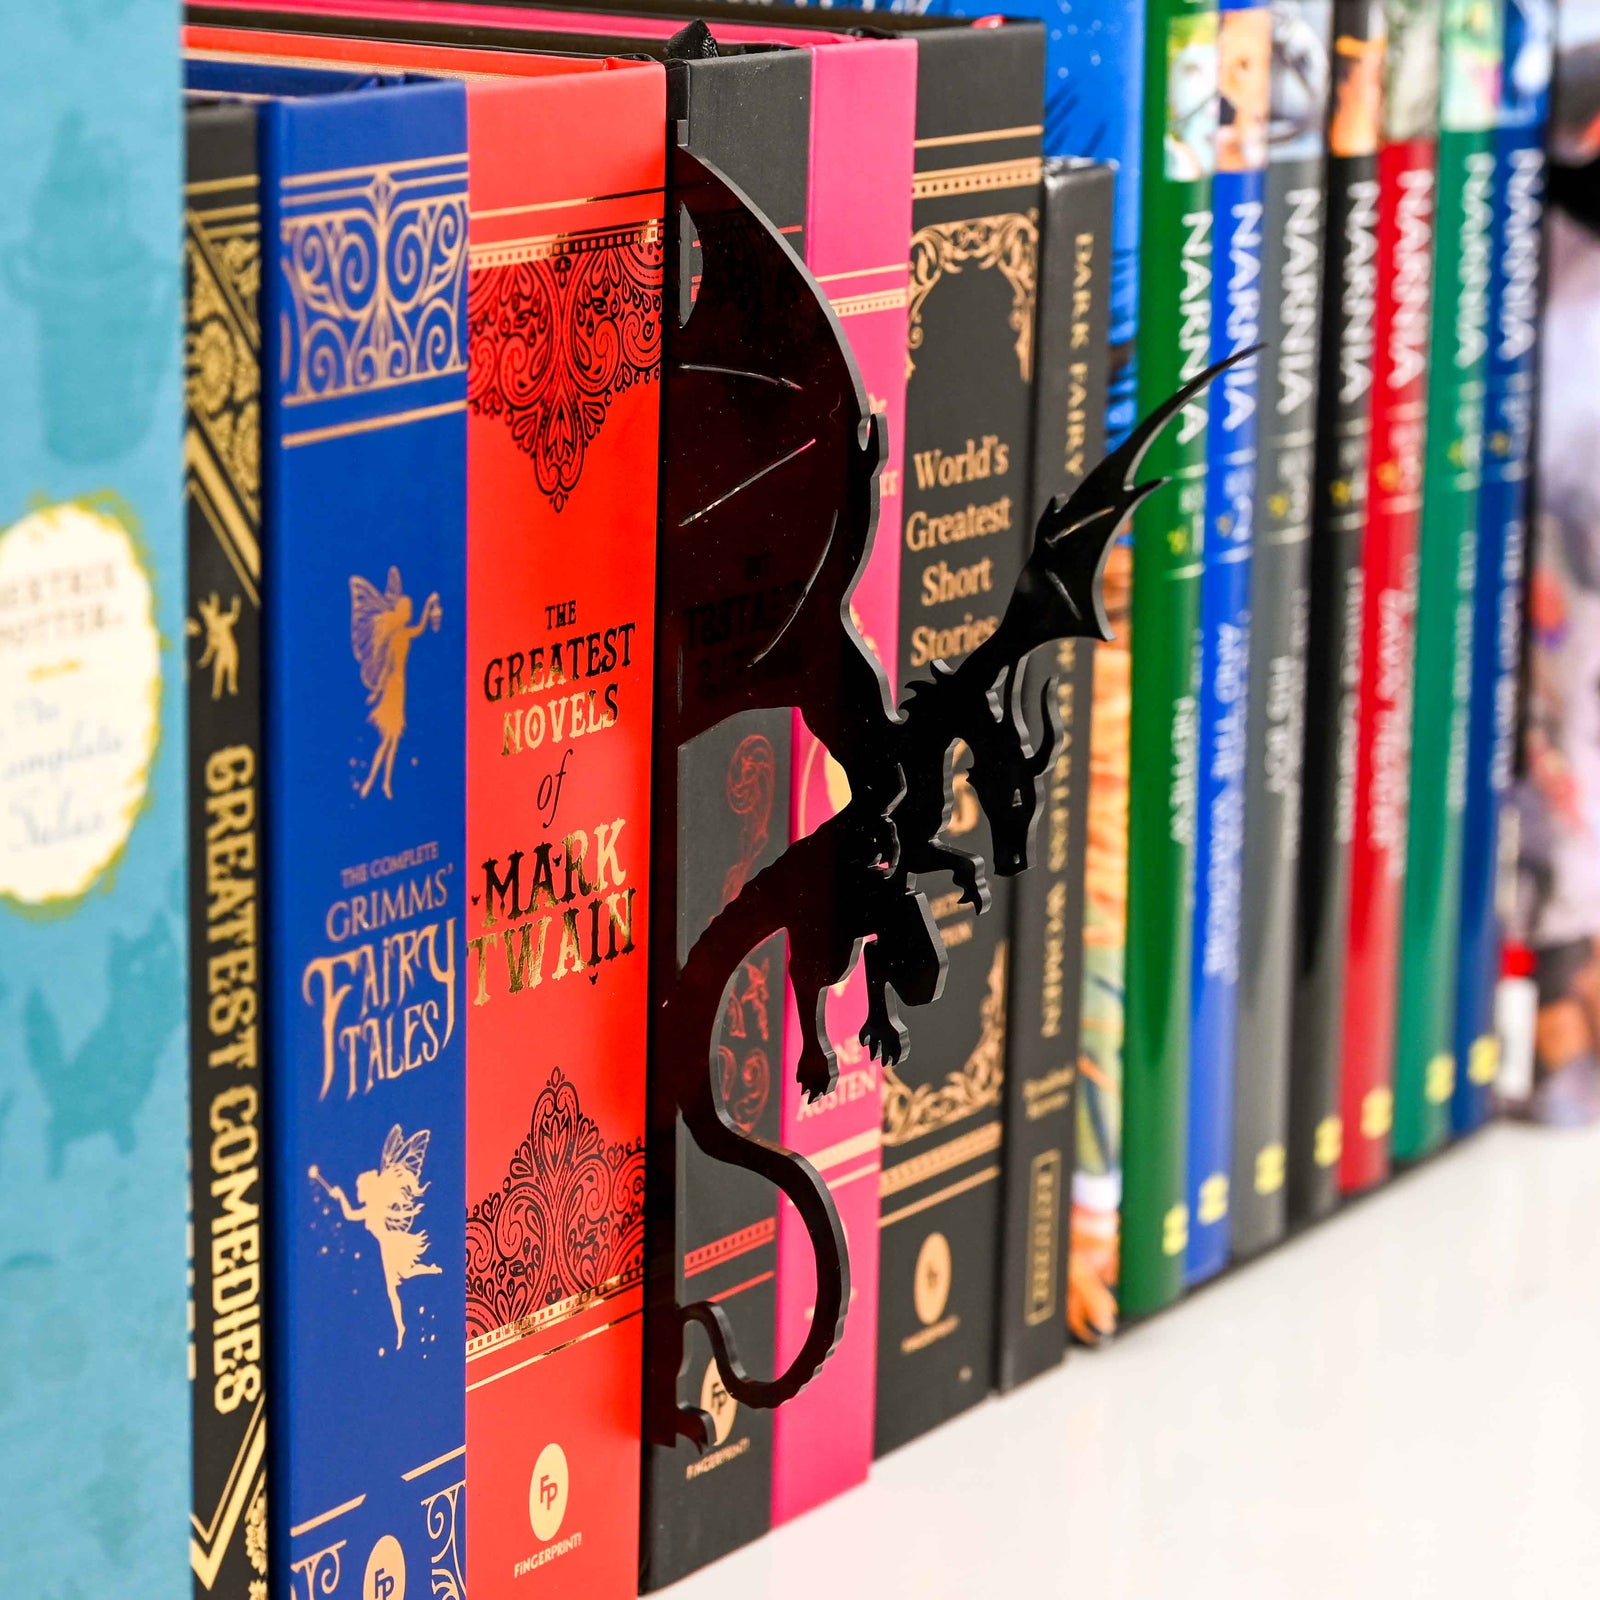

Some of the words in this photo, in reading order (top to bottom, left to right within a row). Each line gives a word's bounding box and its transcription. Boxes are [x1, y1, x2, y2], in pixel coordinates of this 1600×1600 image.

[1070, 232, 1094, 349] DARK
[1276, 187, 1320, 415] NARNIA
[1338, 180, 1380, 404] NARNIA
[1386, 169, 1434, 388] NARNIA
[1454, 151, 1496, 369] NARNIA
[1498, 147, 1545, 361] NARNIA
[1222, 201, 1263, 432] NARNIA
[914, 434, 1010, 490] World's
[1064, 362, 1088, 476] FAIRY
[906, 495, 1012, 552] Greatest
[545, 600, 577, 630] THE
[921, 556, 993, 607] Short
[484, 622, 636, 702] GREATEST
[501, 684, 618, 756] NOVELS
[537, 749, 573, 828] of
[205, 744, 257, 1069] GREATEST
[326, 863, 454, 943] GRIMMS'
[341, 863, 367, 889] THE
[370, 841, 440, 880] COMPLETE
[481, 817, 626, 928] MARK
[467, 888, 636, 1006] TWAIN
[339, 1000, 440, 1101] TALES
[209, 1085, 261, 1415] COMEDIES
[540, 1474, 557, 1511] FP
[375, 1568, 395, 1600] FP
